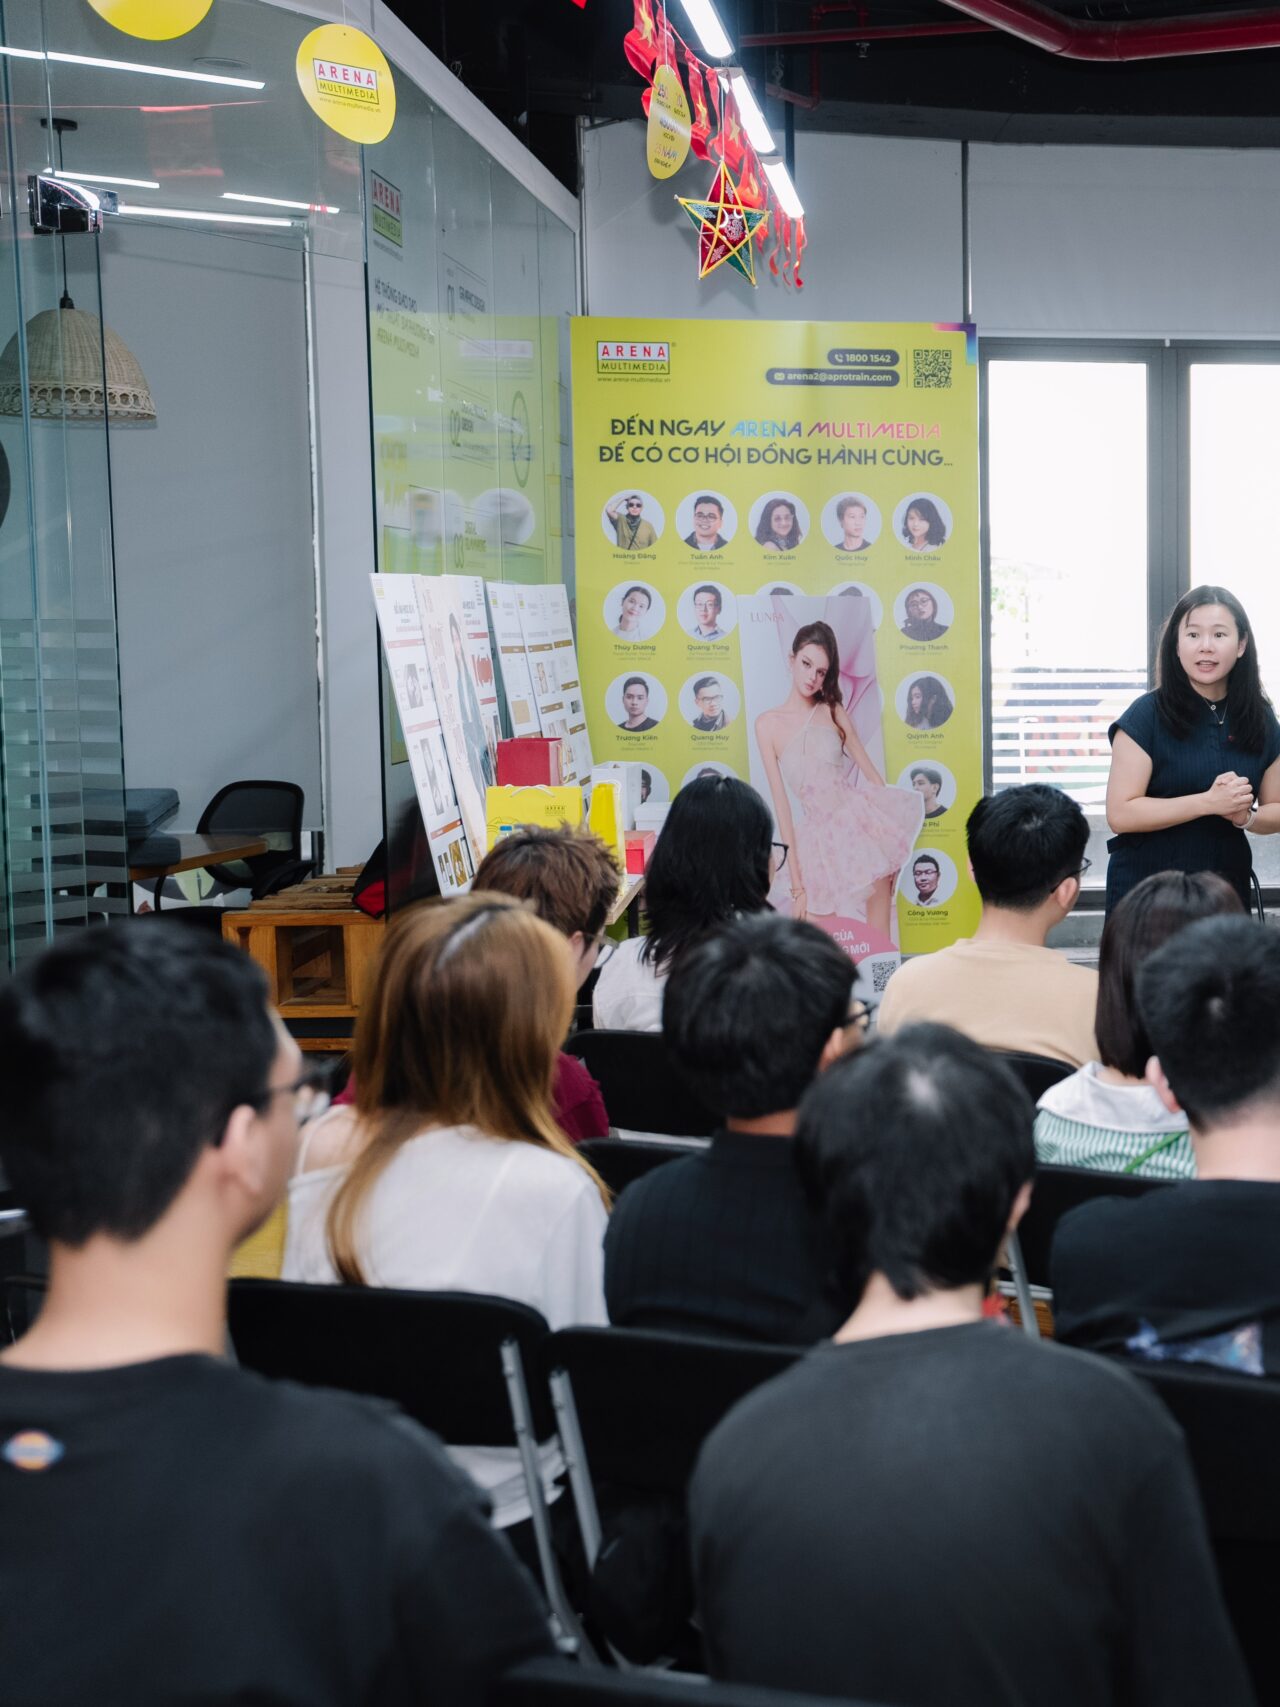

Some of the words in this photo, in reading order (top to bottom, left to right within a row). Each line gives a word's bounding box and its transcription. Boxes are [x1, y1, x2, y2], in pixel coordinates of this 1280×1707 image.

[318, 64, 374, 86] ARENA
[320, 82, 376, 100] MULTIMEDIA
[372, 179, 400, 216] ARENA
[601, 345, 666, 358] ARENA
[845, 354, 868, 363] 1800
[870, 354, 891, 363] 1542
[601, 362, 666, 371] MULTIMEDIA
[787, 372, 892, 382] arena2@aprotrain.com
[611, 413, 654, 436] ĐẾN
[660, 419, 725, 436] NGAY
[731, 420, 802, 438] ARENA
[807, 421, 941, 439] MULTIMEDIA
[631, 442, 663, 463] CÓ
[668, 446, 699, 463] CƠ
[705, 443, 741, 467] HỘI
[747, 442, 812, 464] ĐỒNG
[817, 444, 877, 465] HÀNH
[882, 445, 953, 466] CÙNG...
[687, 644, 711, 652] Quang
[907, 909, 926, 918] Công
[832, 928, 855, 941] CỦA
[850, 941, 870, 954] MỚI
